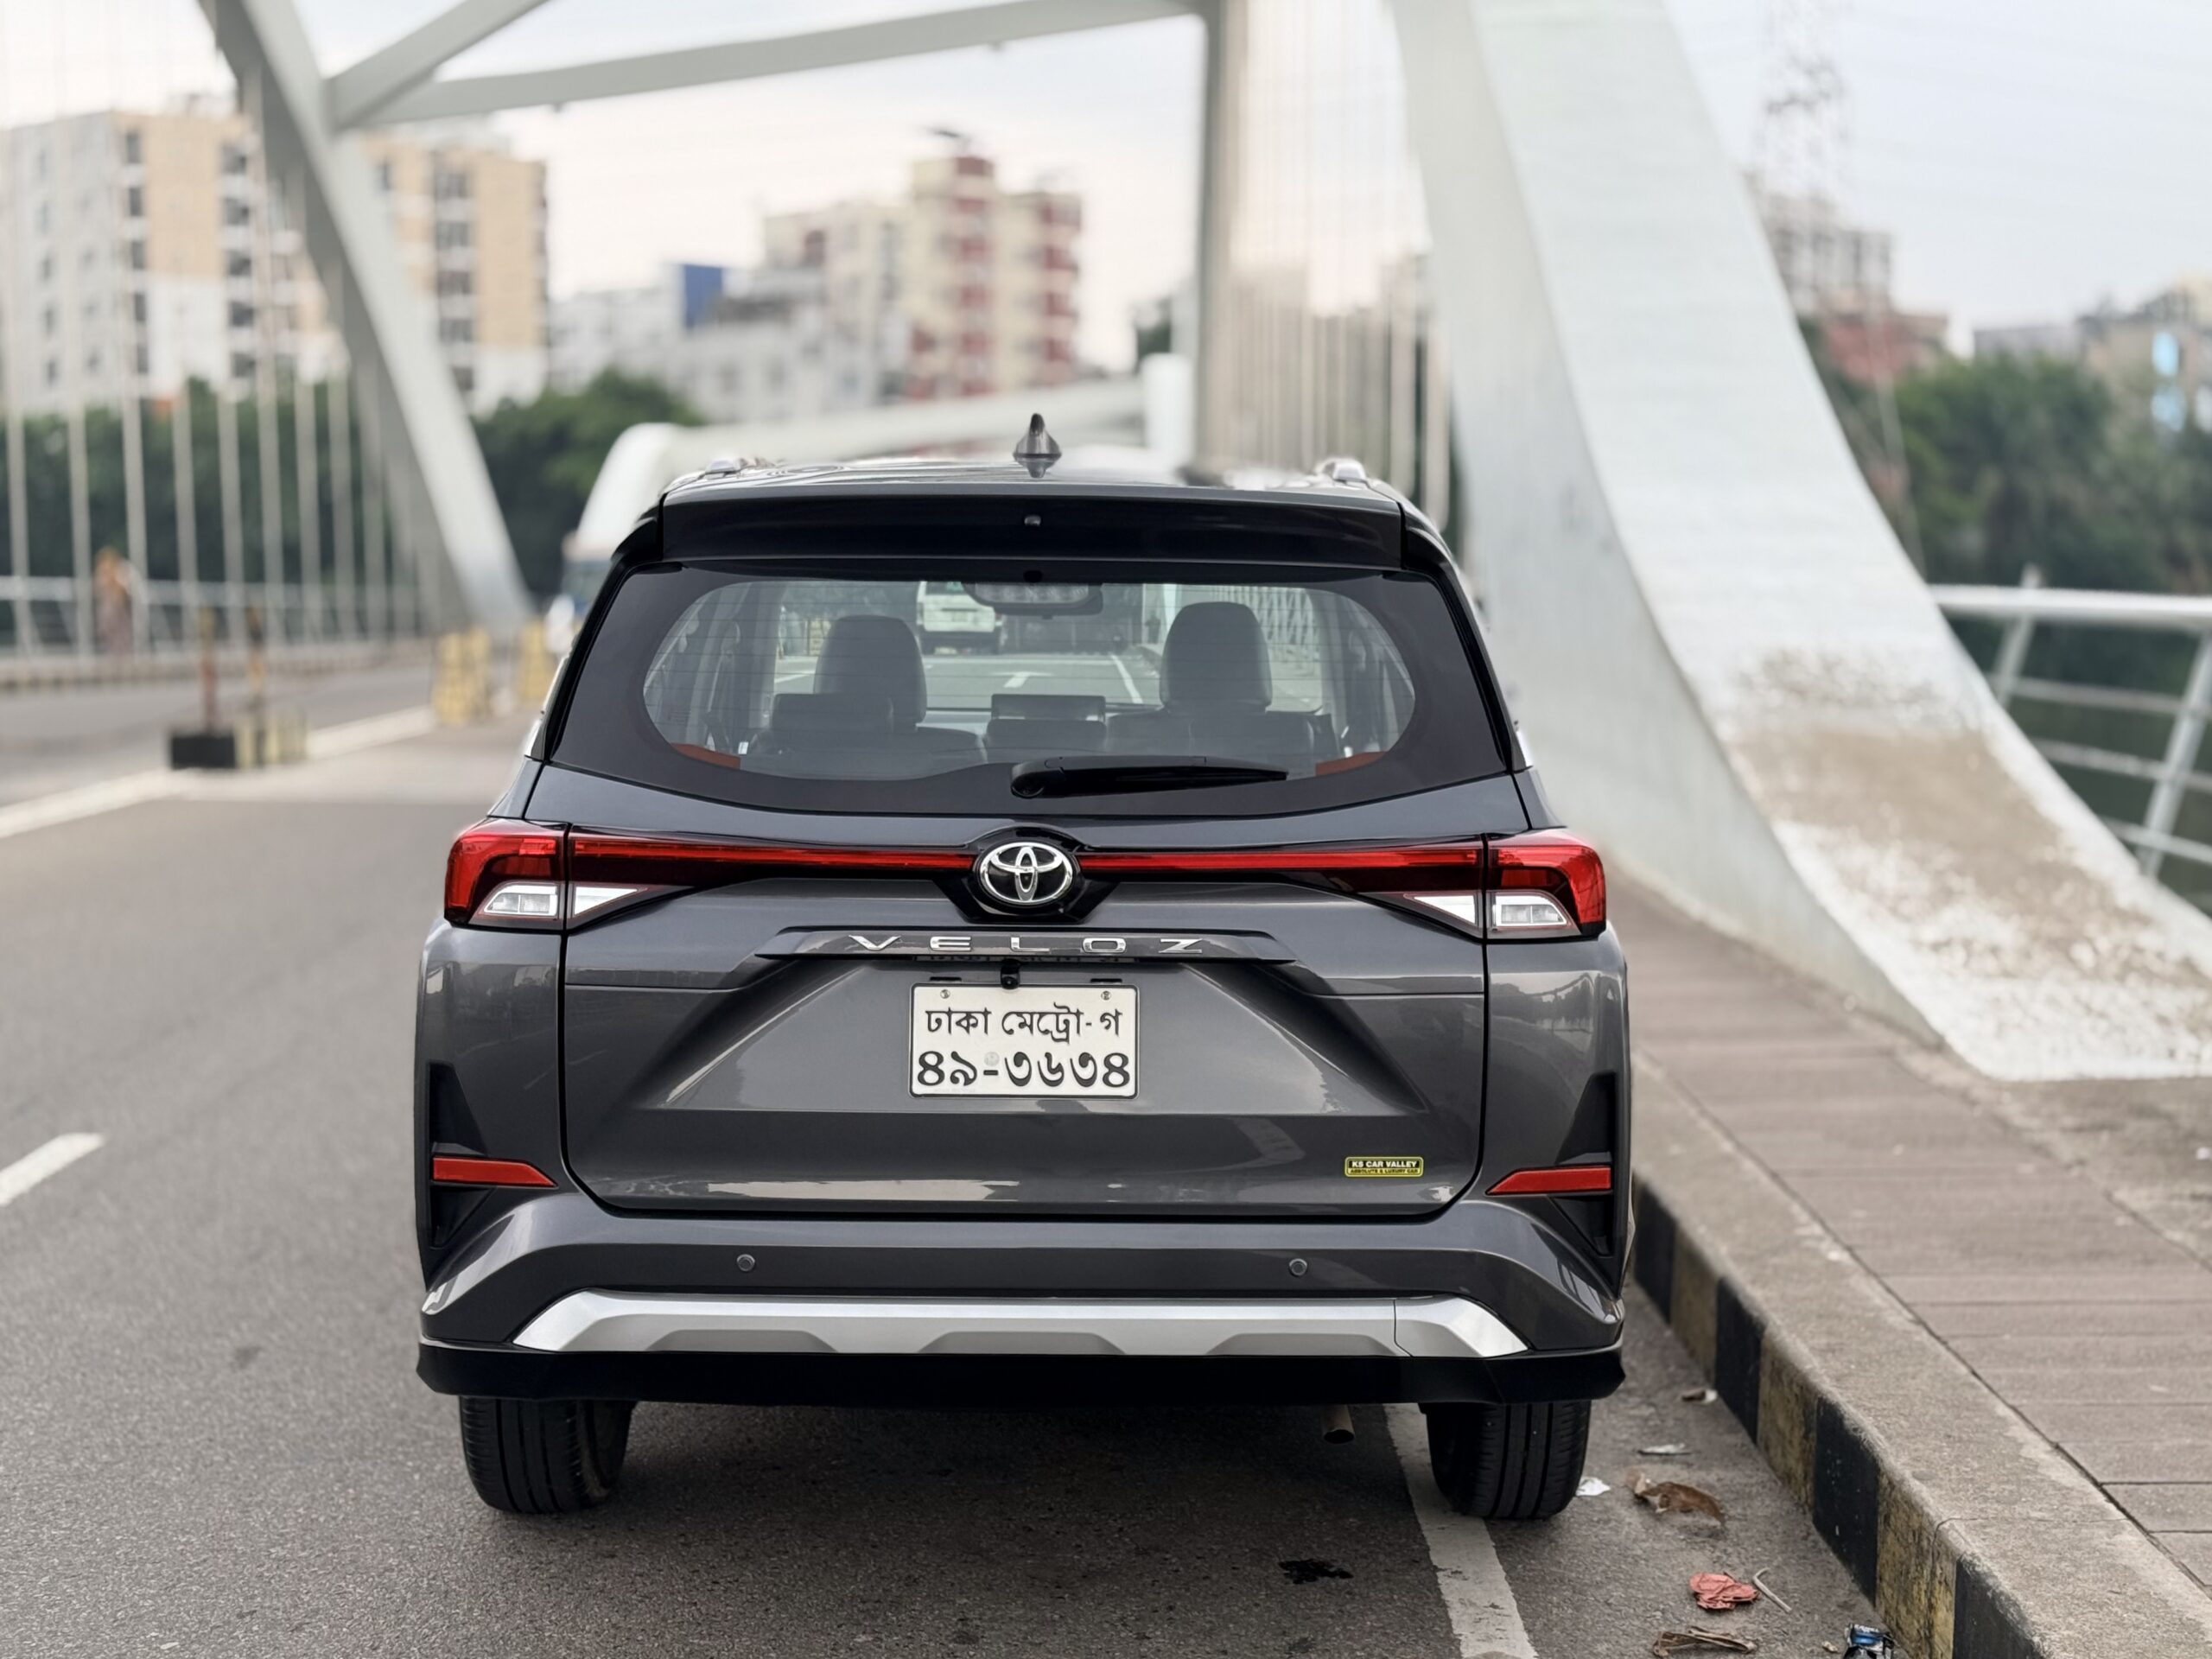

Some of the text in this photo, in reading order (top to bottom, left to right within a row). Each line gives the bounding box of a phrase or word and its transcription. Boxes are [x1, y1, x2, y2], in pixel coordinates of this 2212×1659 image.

[849, 934, 1204, 954] VELOZ
[925, 1007, 992, 1035] ঢাকা
[917, 1050, 1131, 1088] ৪৯-৩৬৩৪
